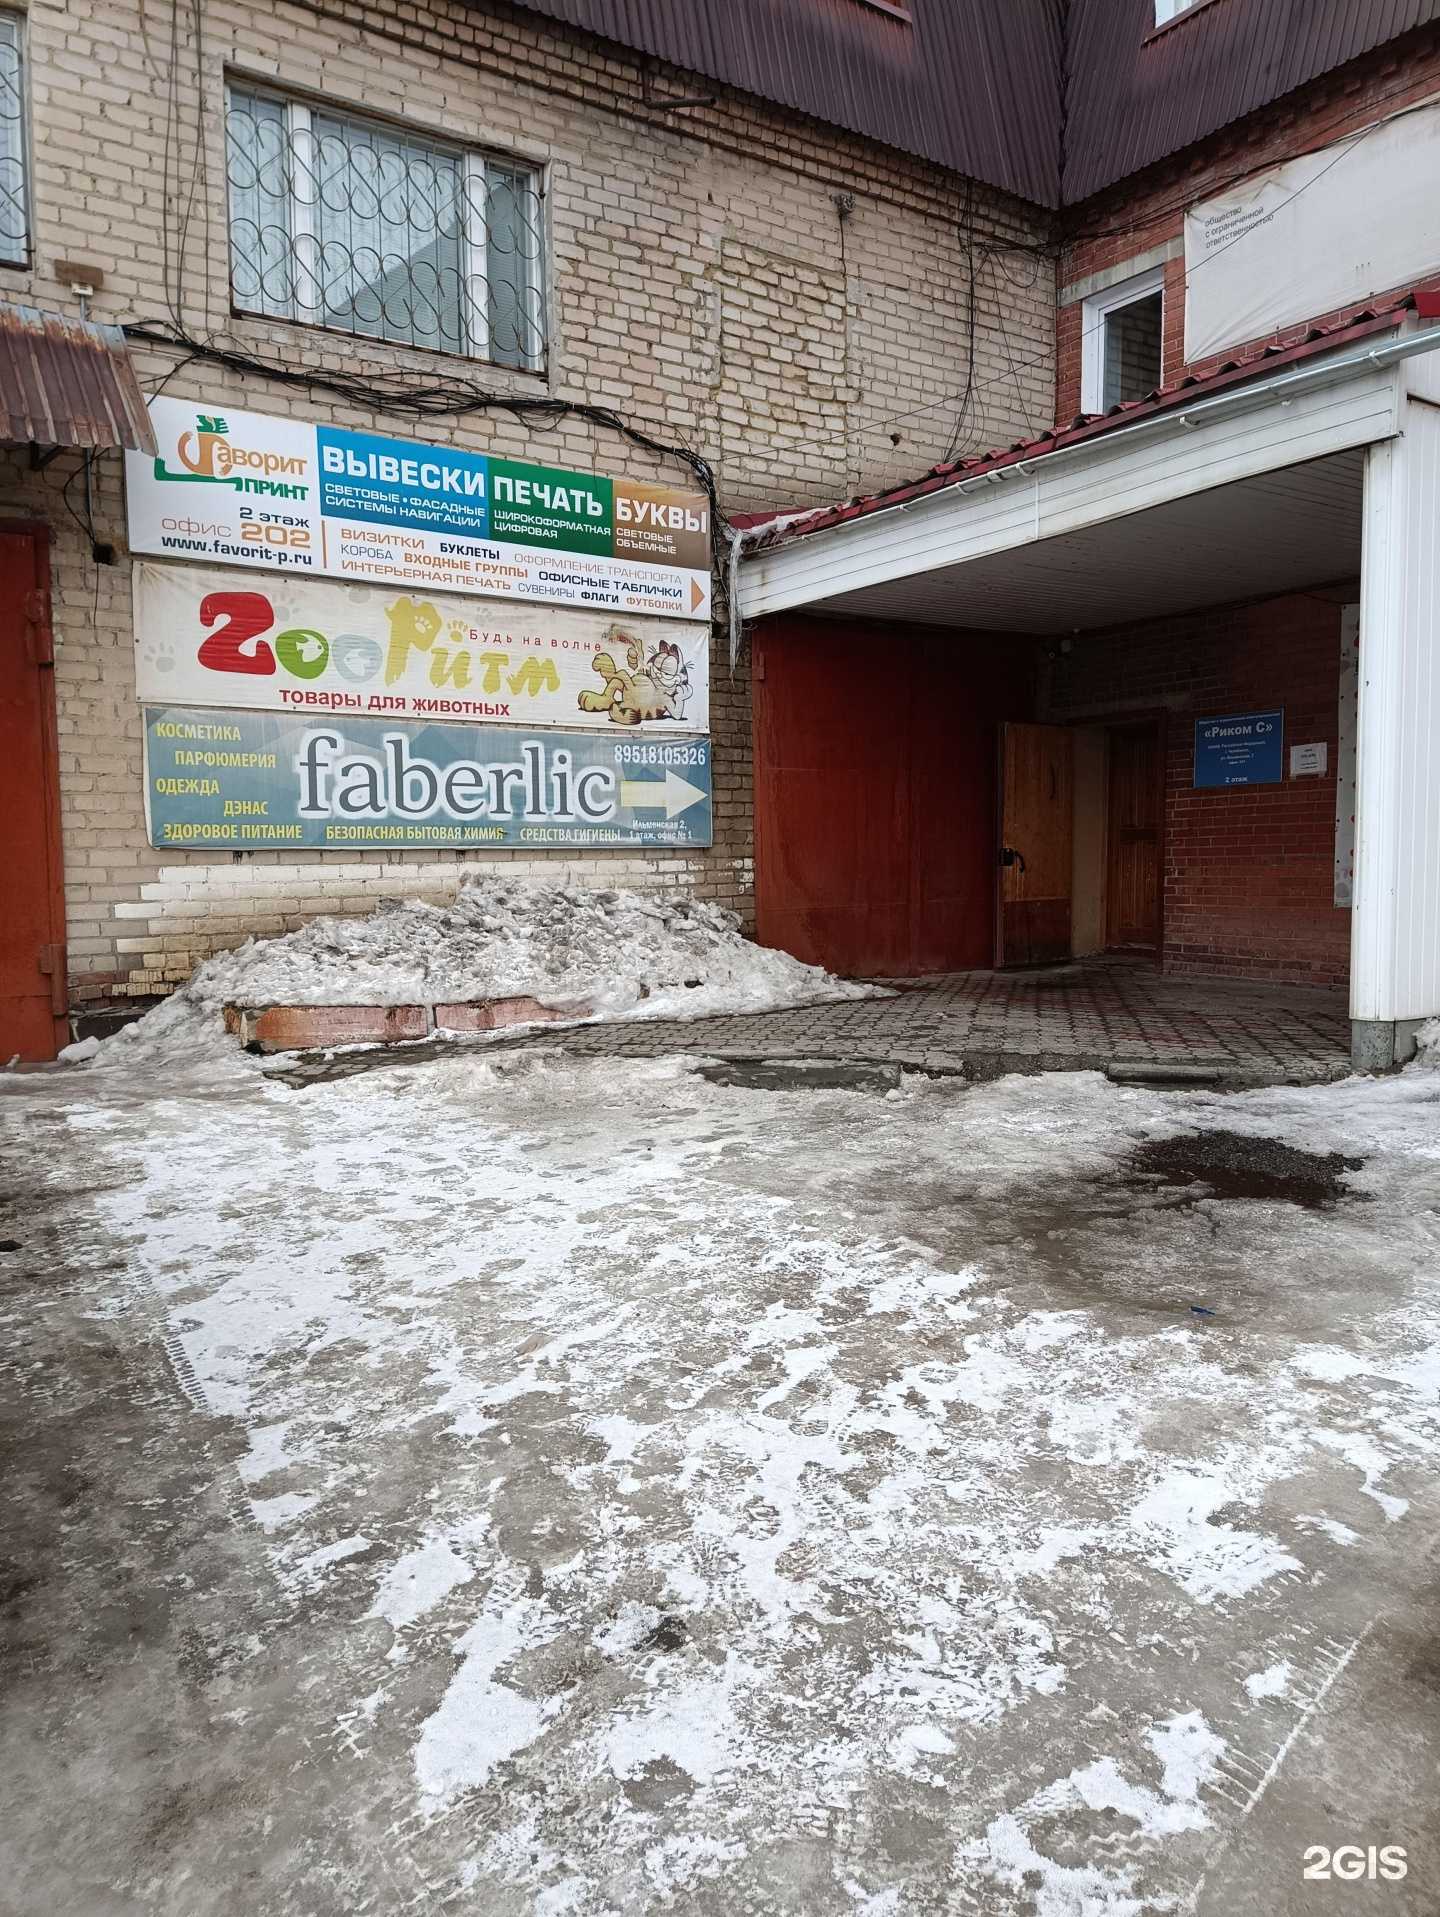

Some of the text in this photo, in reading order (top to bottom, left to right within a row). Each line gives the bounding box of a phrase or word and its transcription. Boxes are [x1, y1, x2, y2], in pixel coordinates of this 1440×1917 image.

[1205, 206, 1242, 227] общество
[1211, 207, 1264, 236] ограниченной
[1206, 215, 1274, 248] ответственностью
[322, 445, 485, 498] ВЫВЕСКИ
[244, 478, 309, 501] ПРИНТ
[324, 483, 486, 517] СВЕТОВЫЕ ФАСАДНЫЕ
[494, 475, 603, 517] ПЕЧАТЬ
[240, 507, 310, 529] 2 этаж
[325, 495, 481, 528] СИСТЕМЫ НАВИГАЦИИ
[494, 510, 611, 536] ШИРОКОФОРМАТНАЯ
[616, 497, 707, 534] БУКВЫ
[161, 516, 311, 549] офис 202
[494, 521, 558, 539] ЦИФРОВАЯ
[616, 528, 673, 544] СВЕТОВЫЕ
[161, 536, 312, 566] www.favorit-p.ru
[341, 528, 682, 585] ВИЗИТКИ БУКЛЕТЫ ОФОРМЛЕНИЕ ТРАНСПОРТА
[616, 538, 677, 554] ОБЪЕМНЫЕ
[340, 543, 682, 598] КОРОБА ВХОДНЫЕ ГРУППЫ ОФИСНЫЕ ТАБЛИЧКИ
[341, 560, 682, 612] ИНТЕРЬЕРНАЯ ПЕЧАТЬ СУВЕНИРЫ ФЛАГИ ФУТБОЛКИ
[469, 628, 602, 653] Будь на волне
[279, 689, 511, 717] товары для животных
[156, 723, 242, 741] КОСМЕТИКА
[1204, 721, 1273, 738] «Риком С»
[175, 750, 277, 769] ПАРФЮМЕРИЯ
[614, 744, 706, 766] 89518105326
[156, 778, 220, 797] ОДЕЖДА
[299, 734, 613, 818] faberlic
[223, 800, 269, 817] ДЭНАС
[163, 823, 238, 839] ЗДОРОВОЕ
[241, 824, 303, 839] ПИТАНИЕ
[326, 825, 404, 841] БЕЗОПАСНАЯ
[406, 826, 461, 841] БЫТОВАЯ
[464, 827, 504, 840] ХИМИЯ
[519, 827, 573, 842] СРЕДСТВА
